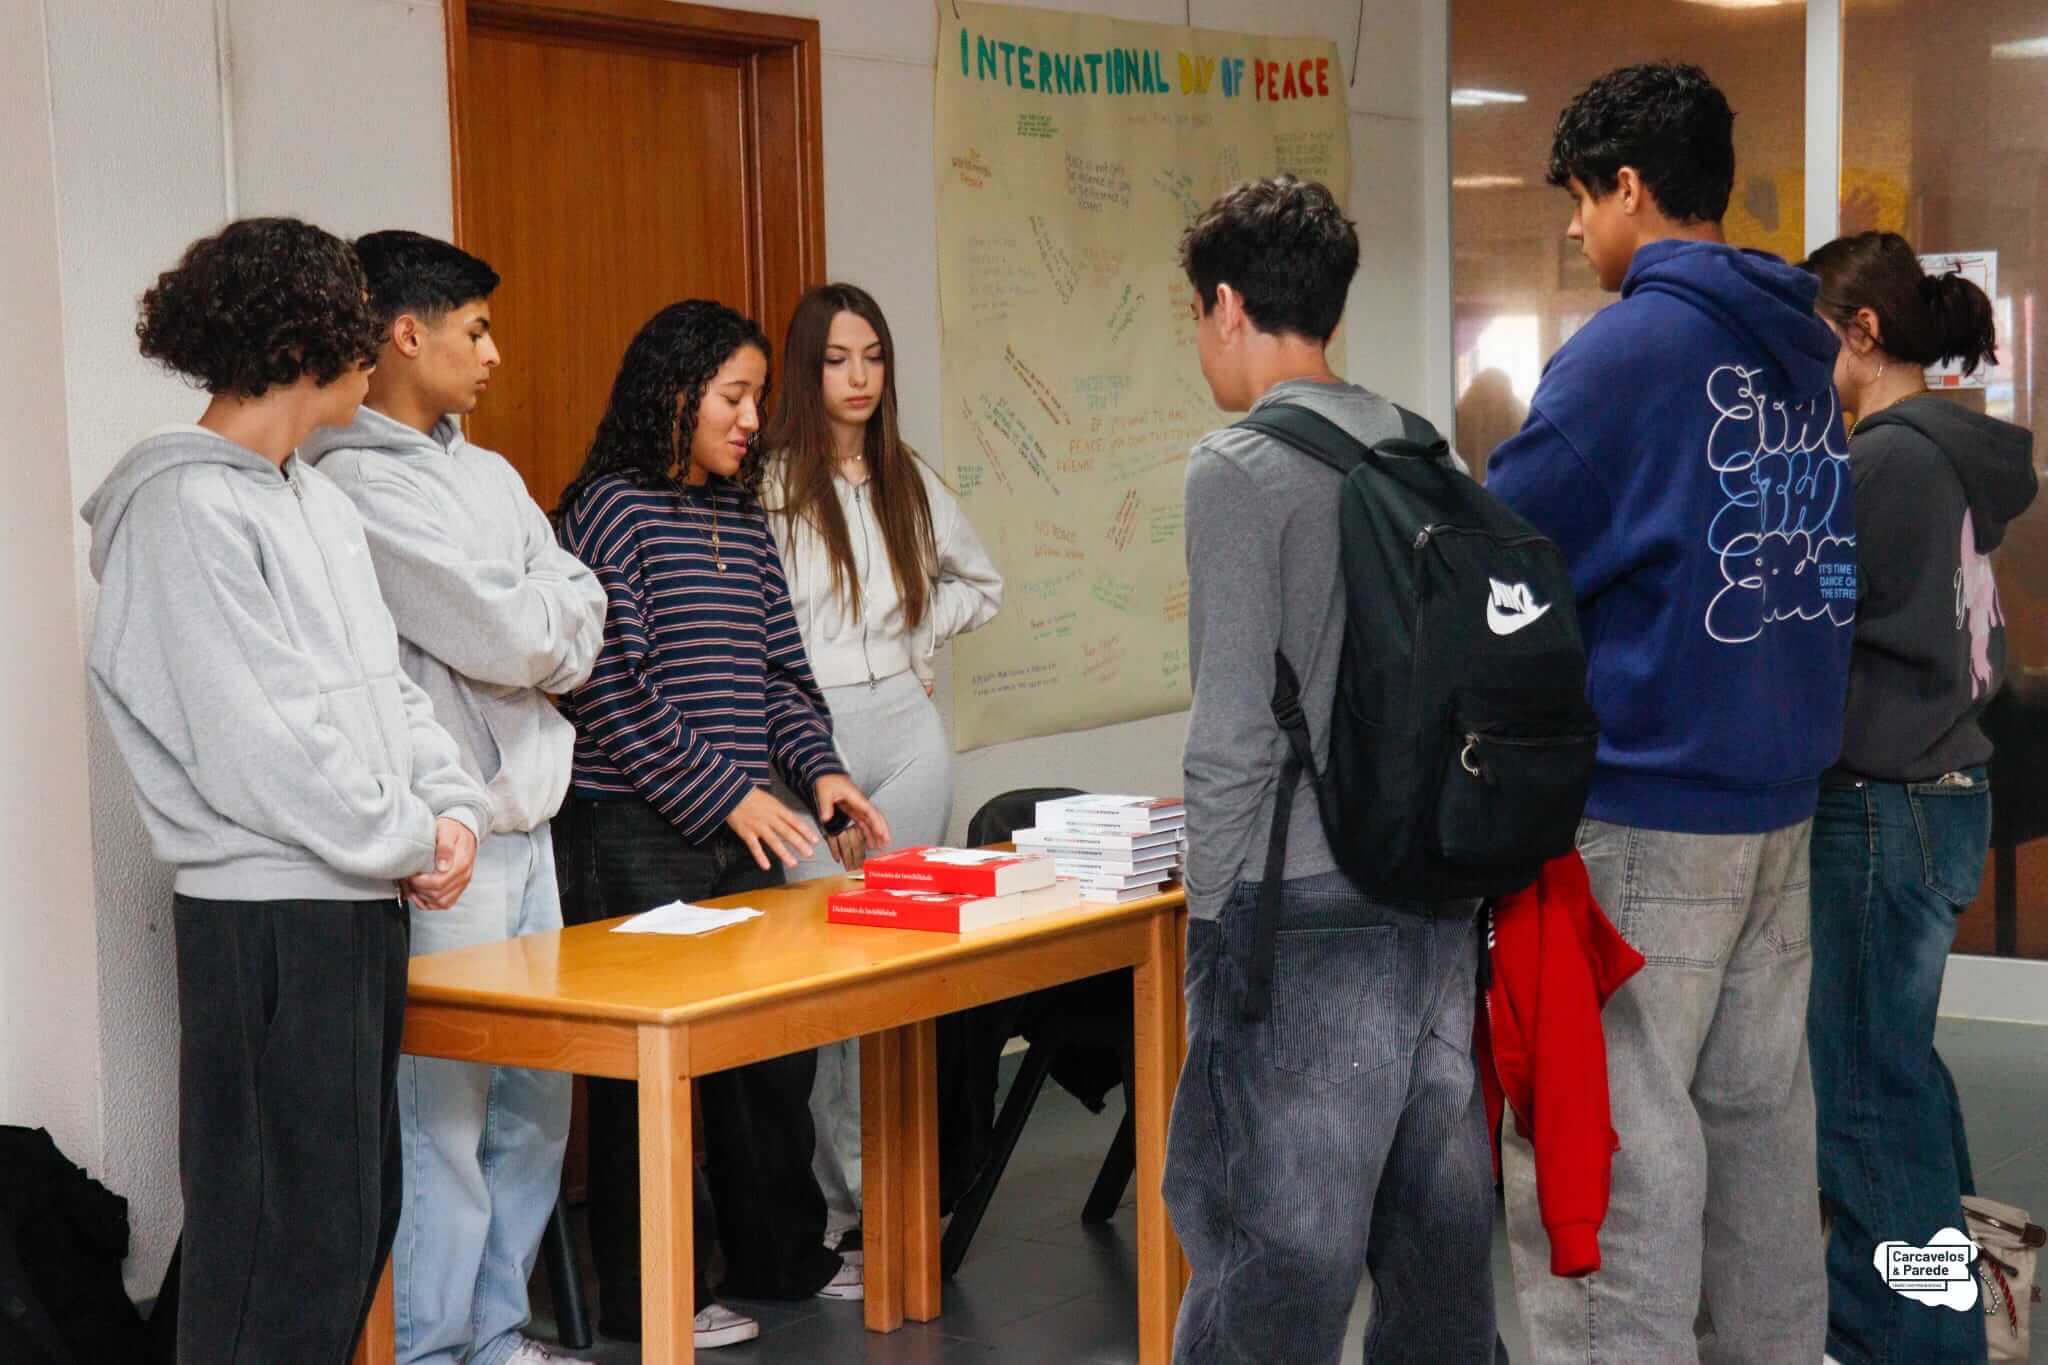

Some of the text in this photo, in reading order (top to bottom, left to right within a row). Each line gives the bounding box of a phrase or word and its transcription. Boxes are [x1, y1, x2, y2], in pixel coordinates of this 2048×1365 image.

[960, 27, 1170, 95] INTERNATIONAL
[1221, 56, 1245, 97] OF
[1254, 58, 1329, 102] PEACE
[1834, 563, 1853, 575] TIME
[1819, 576, 1844, 587] DANCE
